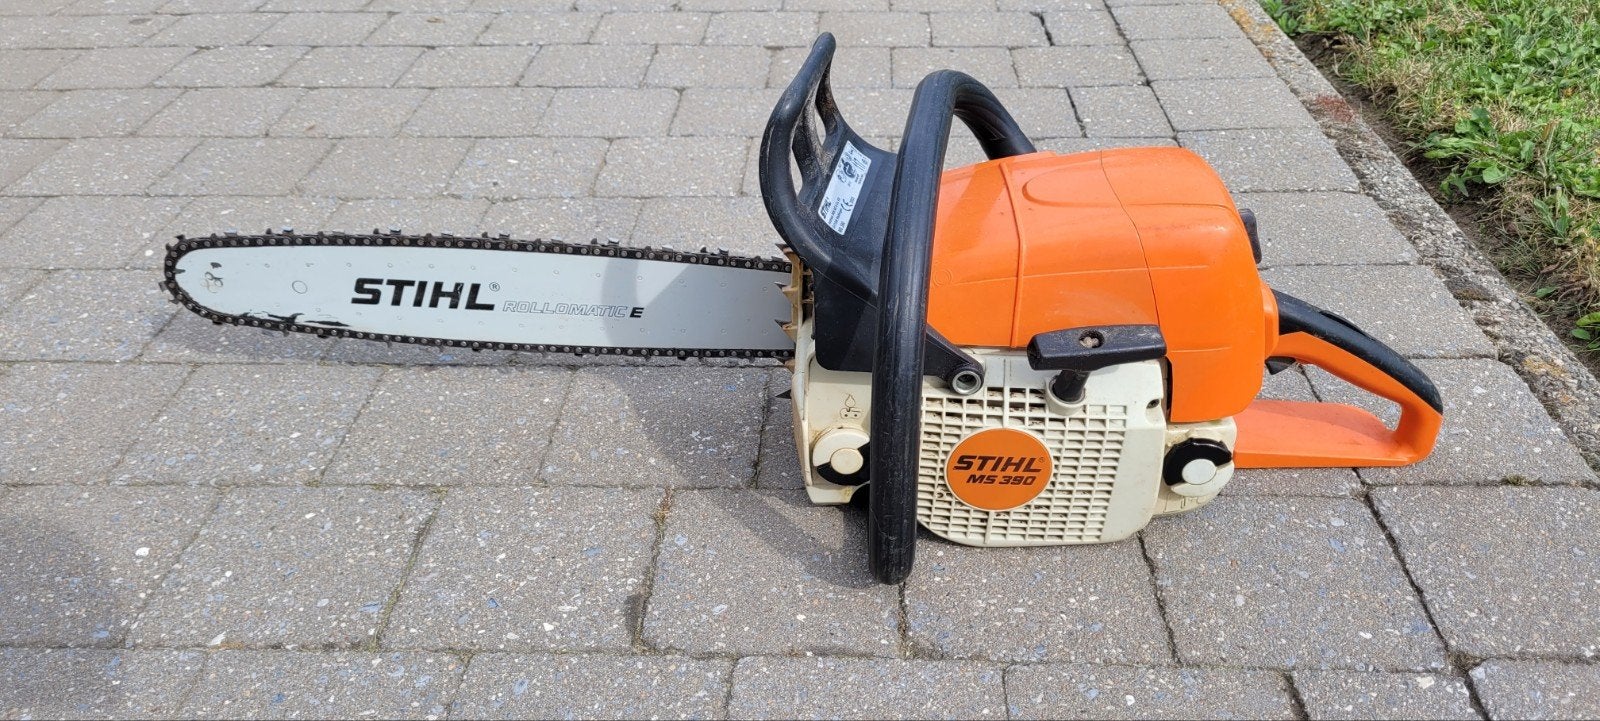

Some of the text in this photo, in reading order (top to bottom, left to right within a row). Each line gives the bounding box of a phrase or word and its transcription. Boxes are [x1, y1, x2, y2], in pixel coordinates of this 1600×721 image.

[351, 277, 645, 318] STIHL ROLLOMATIC E
[953, 455, 1042, 473] STIHL
[966, 474, 1037, 486] MS 390
